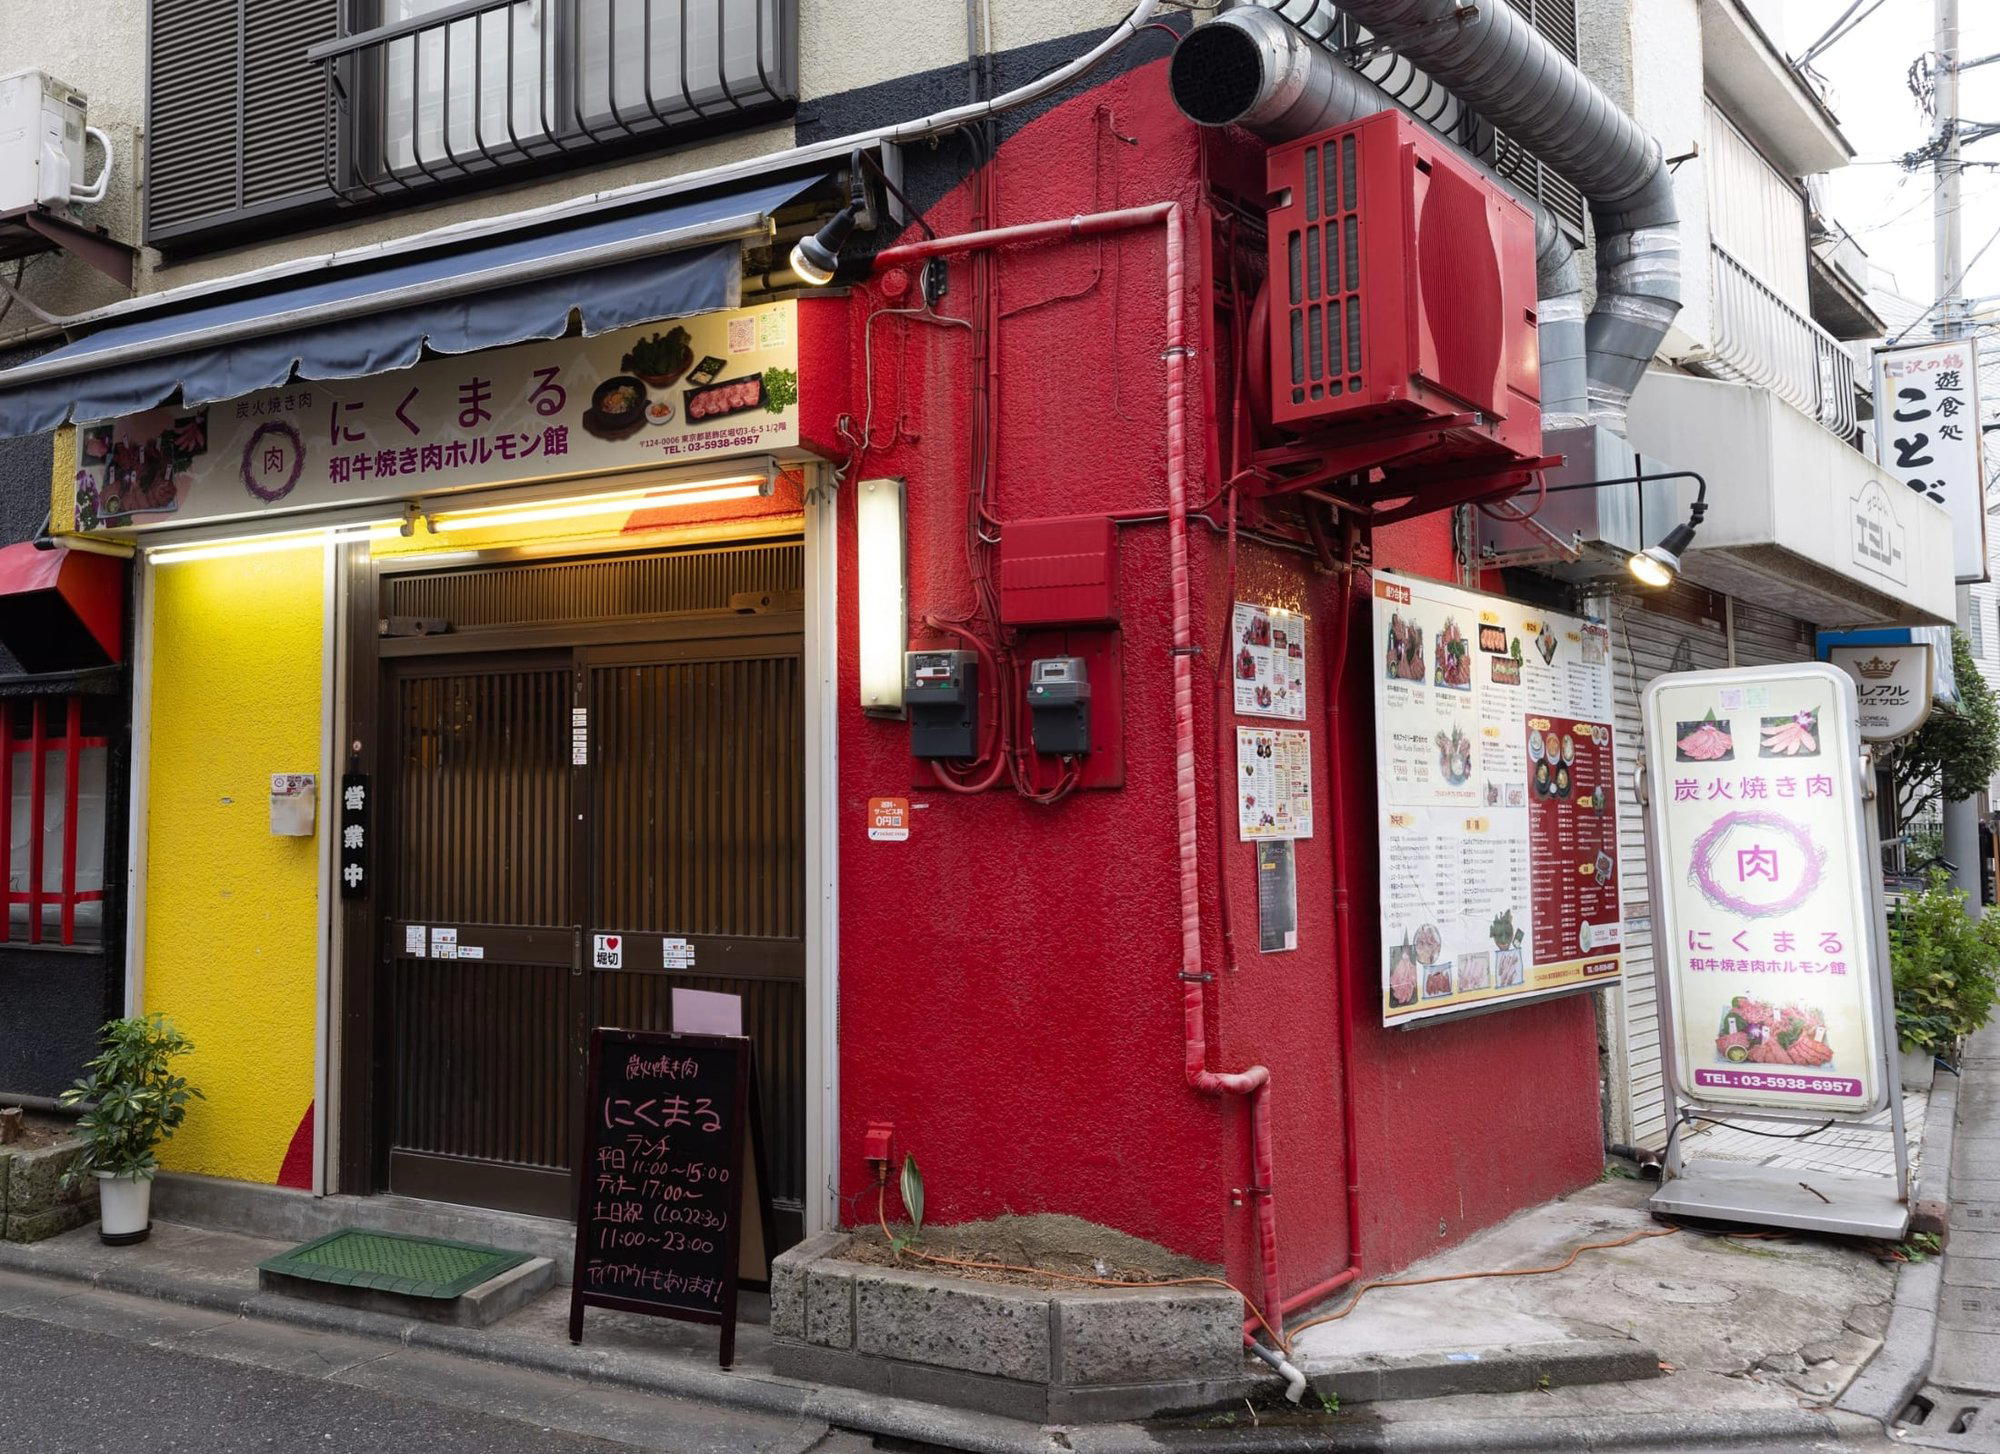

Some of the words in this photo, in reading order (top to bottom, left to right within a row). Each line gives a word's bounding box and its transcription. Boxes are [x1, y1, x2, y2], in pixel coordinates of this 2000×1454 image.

[235, 392, 312, 419] 炭火焼き肉
[331, 366, 568, 446] にくまる
[1934, 370, 1965, 441] 遊食処
[329, 425, 569, 484] 和牛焼き肉ホルモン館
[663, 446, 682, 455] TEL
[688, 435, 760, 452] 03-5938-6957
[264, 446, 284, 475] 肉
[1856, 684, 1910, 696] レアル
[1674, 773, 1833, 801] 炭火焼き肉
[344, 785, 365, 888] 営業中
[1737, 844, 1779, 882] 肉
[598, 937, 605, 950] I
[1688, 930, 1843, 954] にくまる
[596, 951, 619, 966] 堀切
[1689, 958, 1847, 975] 和牛焼き肉ホルモン館
[1703, 1072, 1731, 1085] TEL
[1741, 1075, 1853, 1093] 03-5938-6957
[604, 1095, 722, 1133] にくまる
[597, 1146, 625, 1171] 平日
[626, 1134, 671, 1160] ランチ
[593, 1200, 644, 1224] 土日祝
